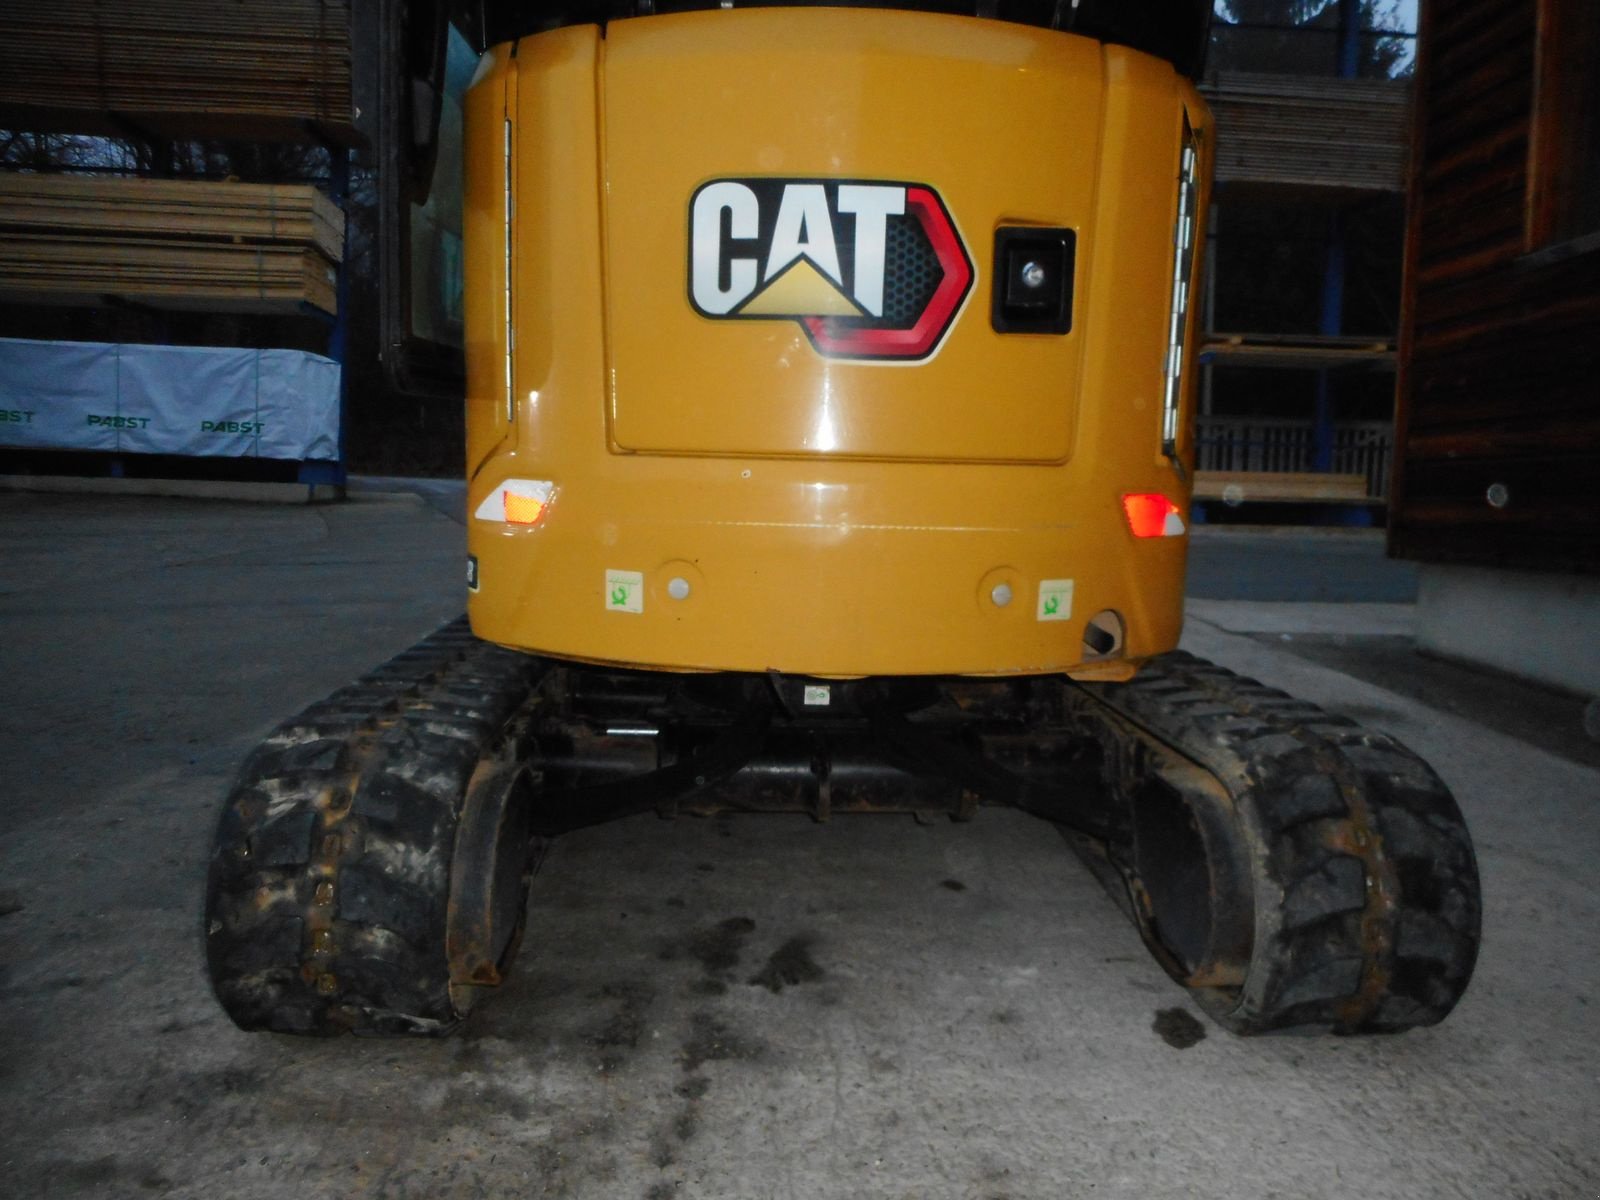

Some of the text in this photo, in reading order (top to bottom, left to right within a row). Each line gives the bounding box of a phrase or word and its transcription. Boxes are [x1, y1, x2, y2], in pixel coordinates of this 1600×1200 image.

[692, 182, 905, 317] CAT
[87, 414, 151, 429] PABST
[201, 420, 265, 434] PABST
